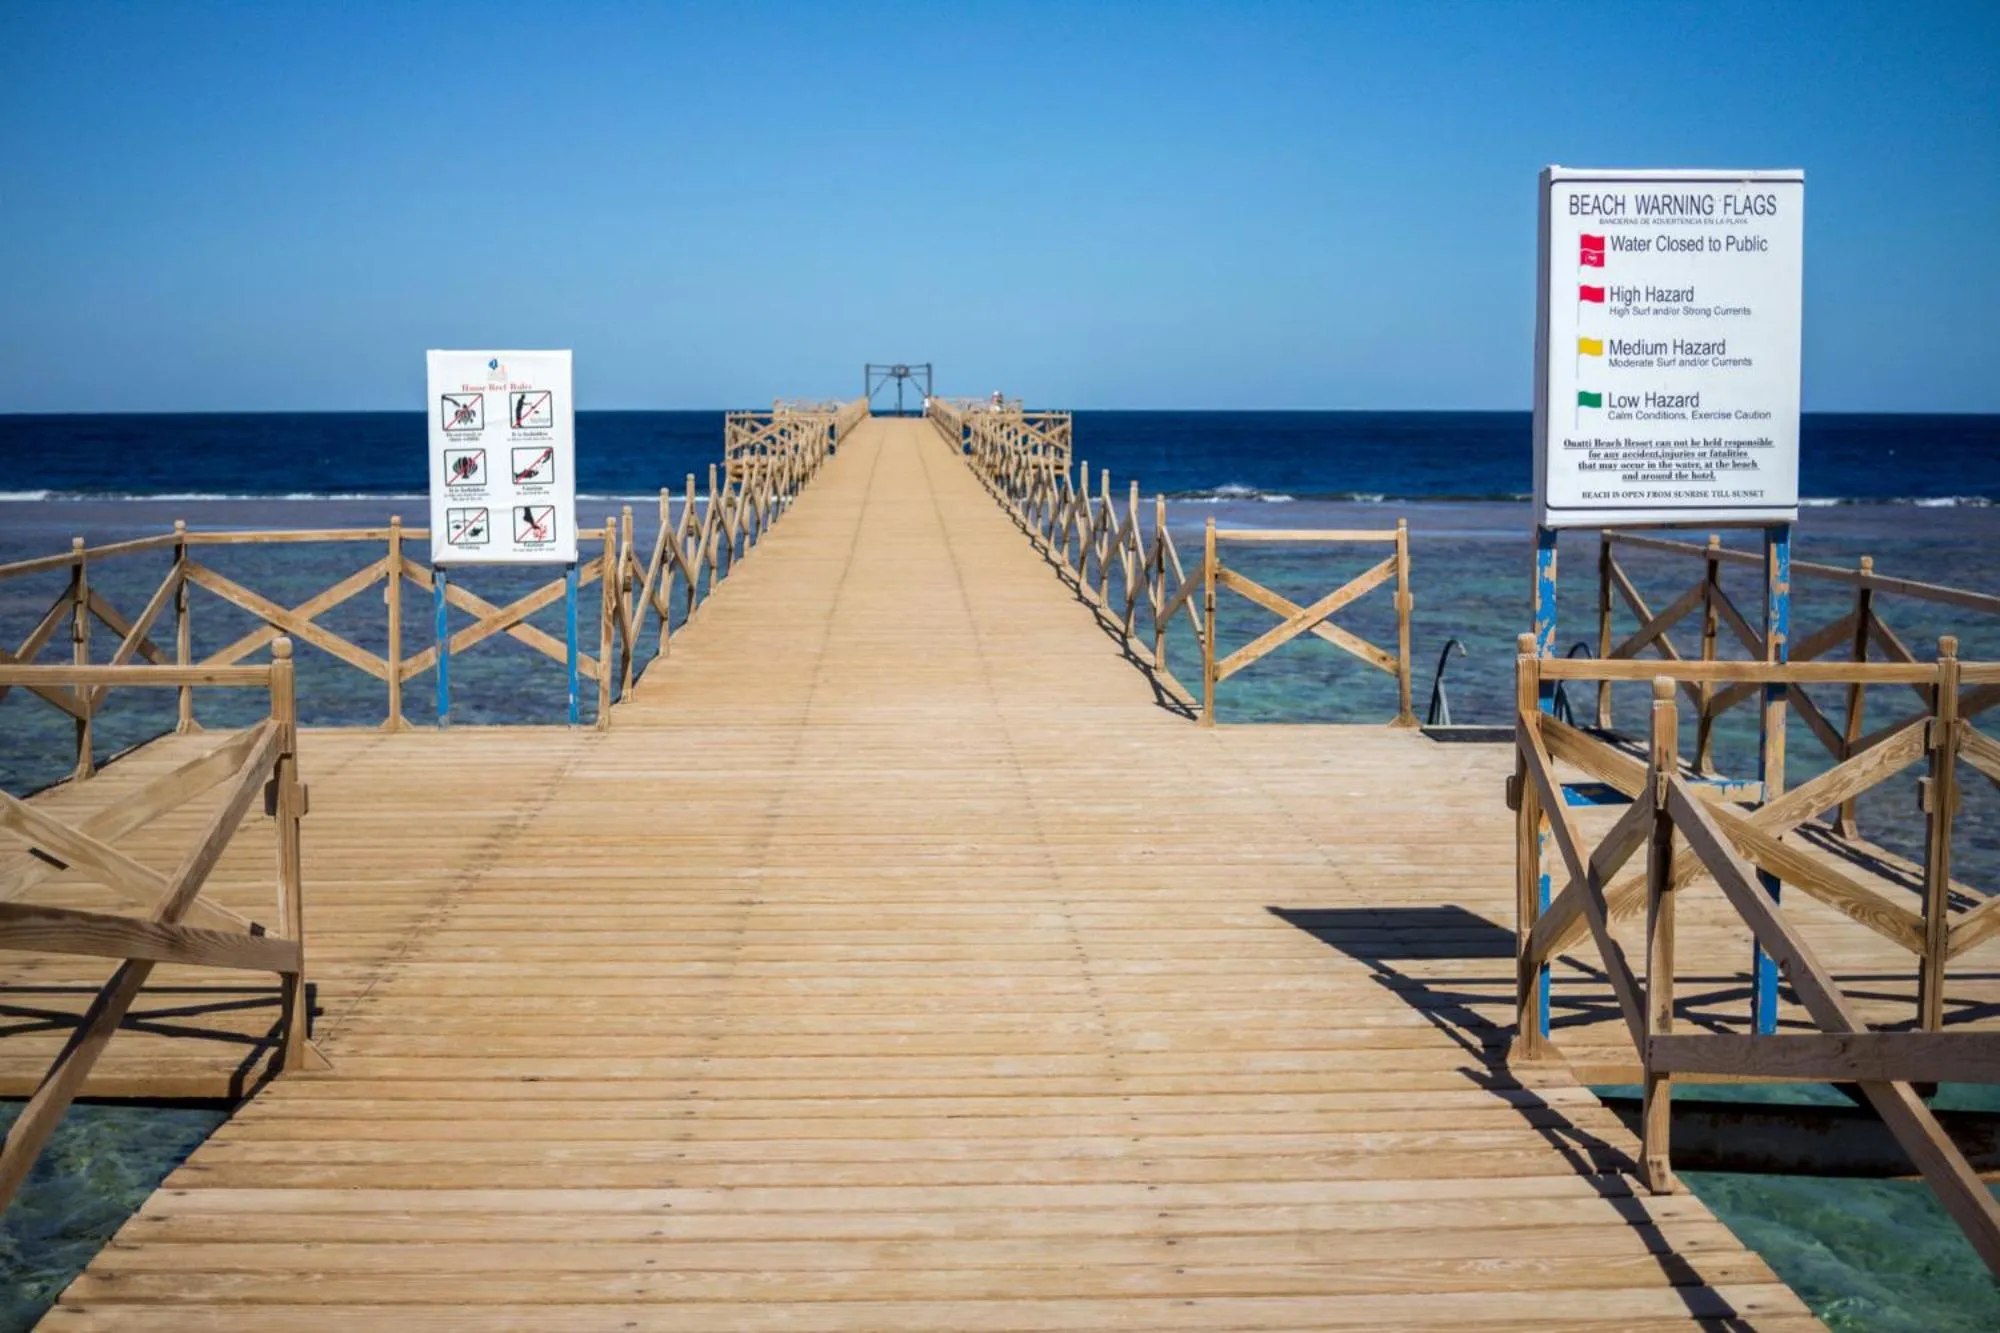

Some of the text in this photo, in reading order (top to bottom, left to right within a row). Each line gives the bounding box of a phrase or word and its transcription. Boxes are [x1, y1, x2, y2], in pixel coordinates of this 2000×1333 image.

[1569, 194, 1777, 216] BEACH WARNING FLAGS
[1610, 235, 1768, 252] Water Closed to Public
[1609, 286, 1694, 306] High Hazard
[1609, 307, 1751, 318] High Surf and/or Strong Currents
[1609, 339, 1726, 356] Medium Hazard
[1608, 358, 1752, 367] Moderate Surf and/or Currents
[1608, 392, 1700, 409] Low Hazard
[1608, 410, 1633, 420] Calm
[1691, 410, 1731, 420] Exercise
[1734, 410, 1771, 420] Caution
[1594, 438, 1622, 447] Beach
[1624, 438, 1653, 447] Resort
[1674, 438, 1688, 446] not
[1691, 438, 1701, 446] be
[1703, 437, 1722, 446] held
[1724, 437, 1773, 448] responsible
[1588, 450, 1601, 458] for
[1603, 452, 1619, 460] any
[1709, 449, 1748, 457] fatalities
[1578, 460, 1596, 469] that
[1599, 462, 1618, 470] may
[1647, 460, 1656, 469] in
[1659, 460, 1672, 469] the
[1716, 459, 1730, 468] the
[1732, 459, 1758, 468] beach
[1622, 471, 1638, 480] and
[1641, 471, 1672, 480] around
[1675, 471, 1688, 480] the
[1732, 490, 1764, 498] SUNSET
